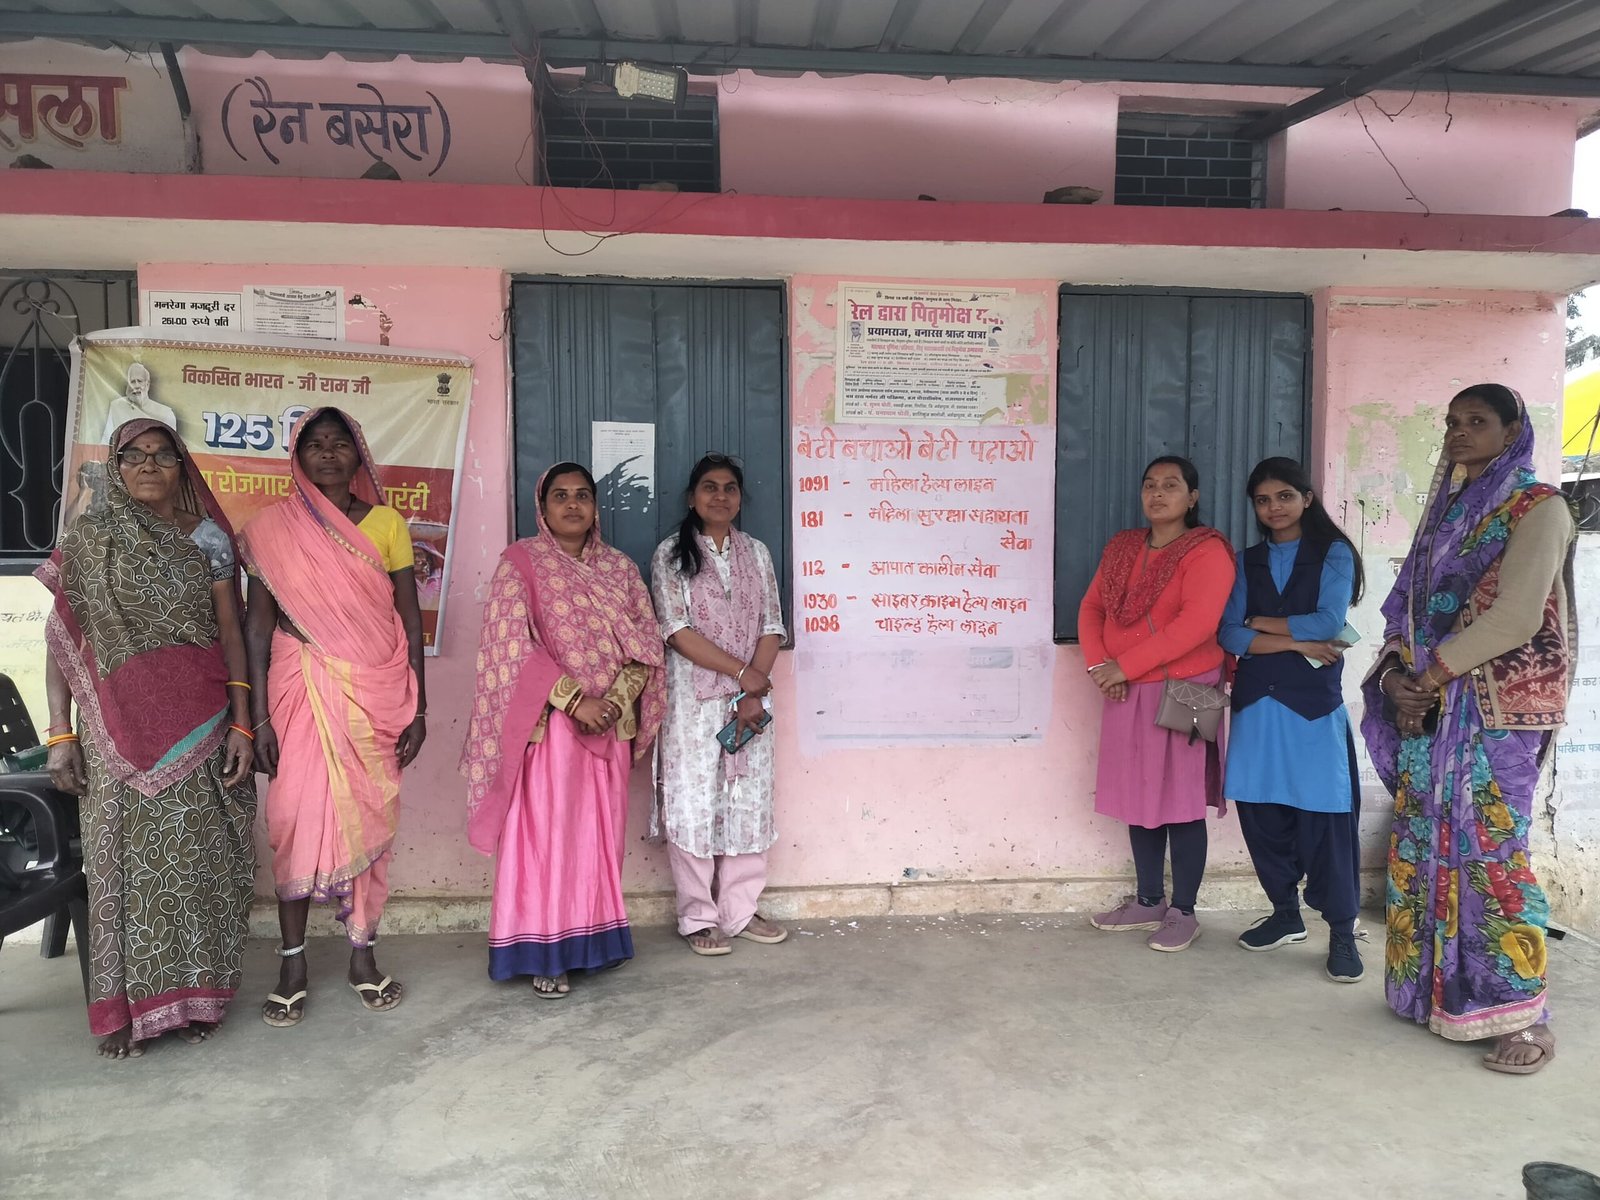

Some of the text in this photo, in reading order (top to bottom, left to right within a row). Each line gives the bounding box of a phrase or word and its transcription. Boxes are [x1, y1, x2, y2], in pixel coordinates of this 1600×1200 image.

[319, 83, 451, 177] बसेरा)
[154, 299, 235, 313] मनरेगा मजदूरी दर
[848, 299, 874, 320] रेल
[878, 304, 907, 322] द्वारा
[911, 302, 972, 328] पितृमोक्ष
[867, 327, 911, 339] प्रयागराज,
[914, 328, 942, 338] बनारस
[967, 329, 987, 340] यात्रा
[182, 364, 241, 386] विकसित
[244, 372, 284, 389] भारत
[297, 372, 317, 391] जी
[320, 377, 348, 393] राम
[352, 375, 371, 395] जी
[202, 411, 275, 451] 125
[797, 426, 842, 460] बेटी
[842, 428, 912, 462] बचाओ
[917, 428, 963, 462] बेटी
[216, 465, 293, 497] रोजगार
[799, 475, 829, 492] 1091
[867, 468, 919, 494] महिला
[953, 478, 997, 494] लाइन
[801, 510, 824, 528] 181
[868, 500, 912, 523] महिला
[917, 509, 968, 527] सुरक्षा
[968, 508, 1030, 526] सहायता
[1000, 529, 1034, 551] सेवा
[802, 559, 825, 577] 112
[868, 561, 915, 576] आपात
[917, 554, 966, 577] कालीन
[967, 557, 1000, 578] सेवा
[803, 593, 838, 610] 1930
[871, 592, 920, 610] साइबर
[991, 597, 1032, 614] लाइन
[805, 614, 840, 633] 1098
[960, 619, 1002, 638] लाइन
